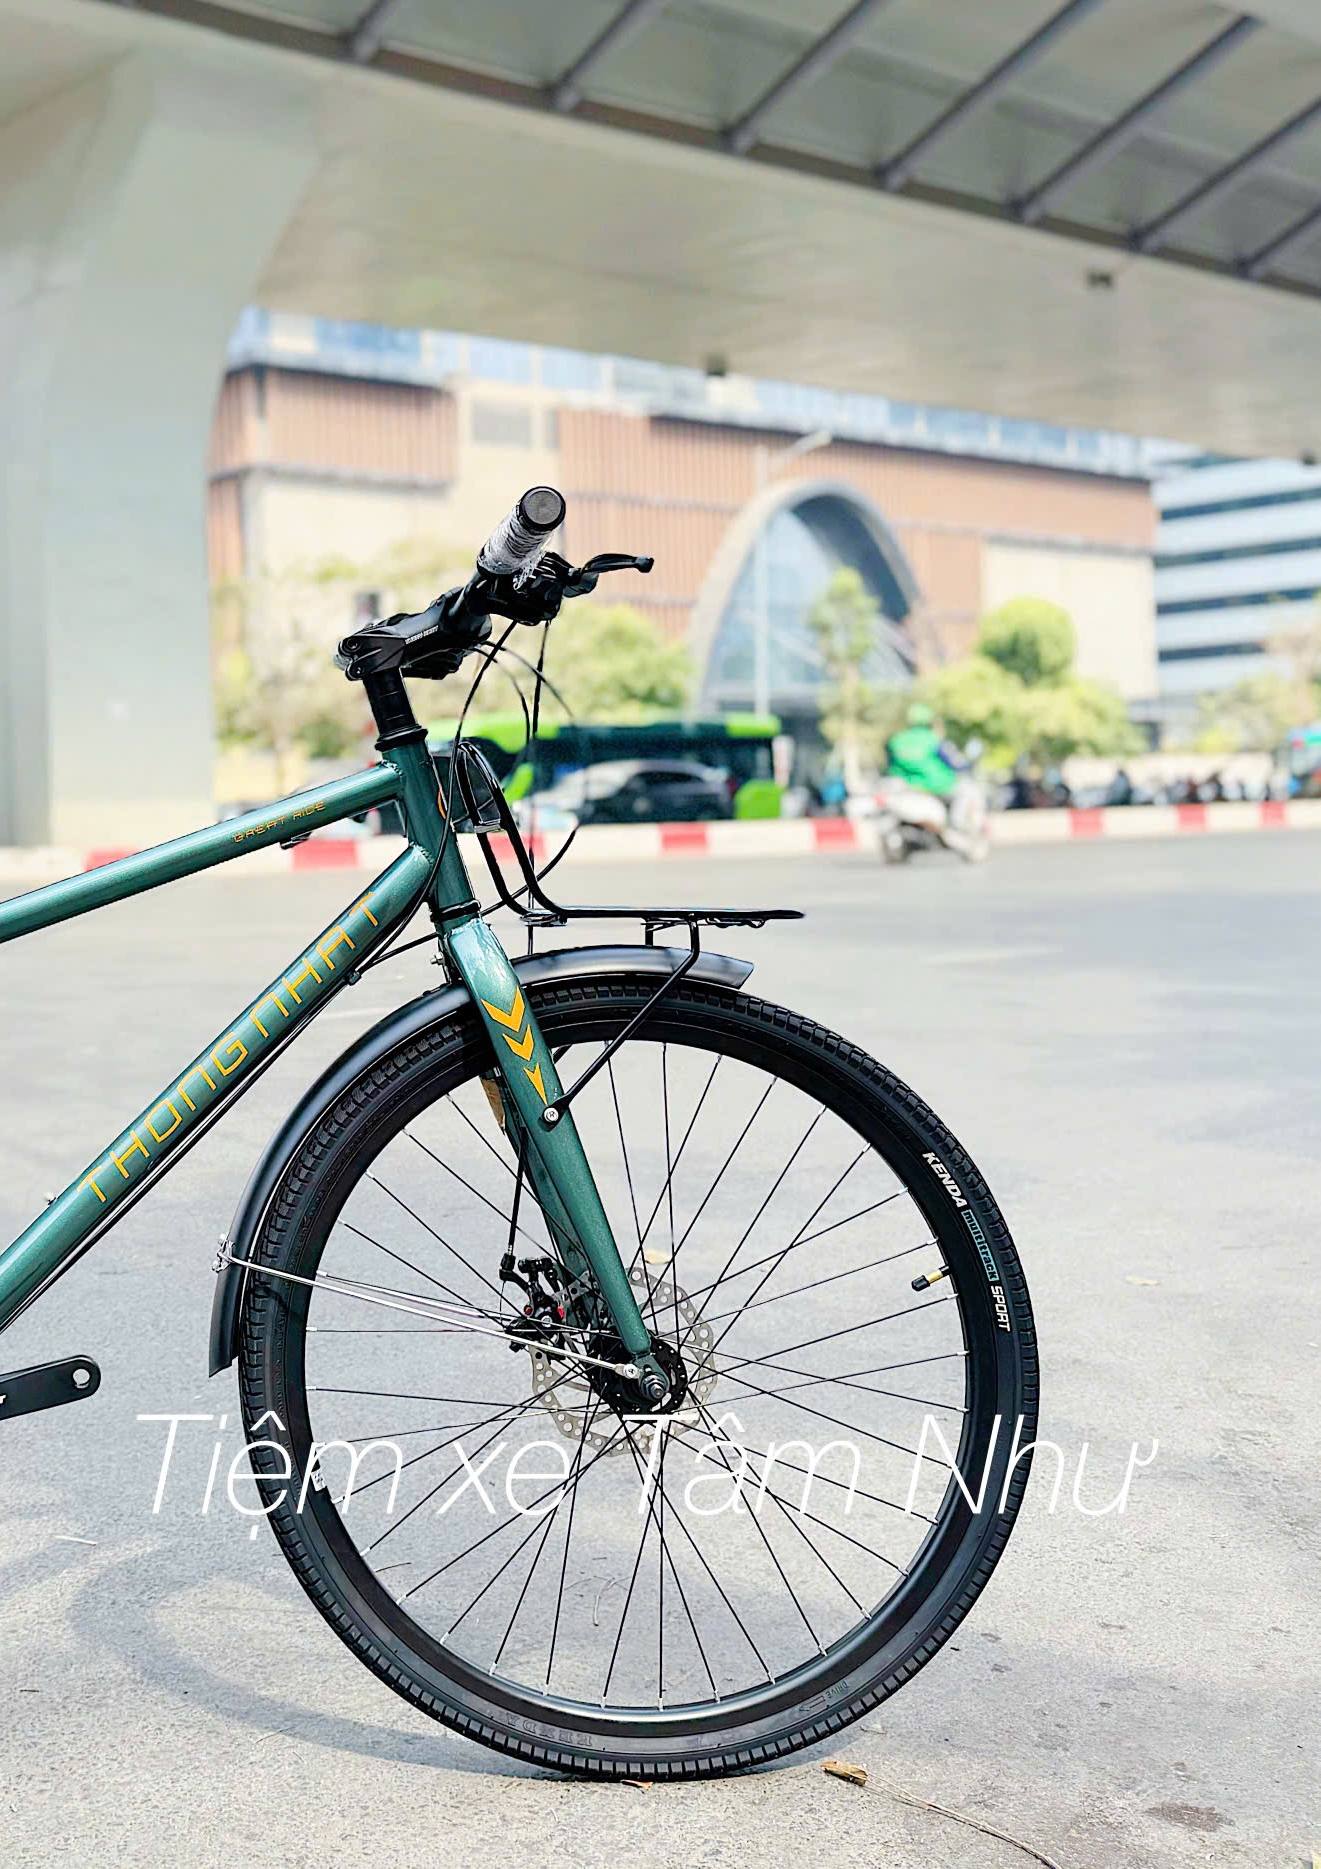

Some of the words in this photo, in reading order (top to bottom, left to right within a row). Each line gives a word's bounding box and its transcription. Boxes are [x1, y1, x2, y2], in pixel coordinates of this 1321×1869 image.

[232, 816, 287, 844] GREAT
[292, 801, 327, 821] RIDE
[922, 1151, 968, 1209] KENDA
[962, 1211, 999, 1281] multitrack
[990, 1285, 1011, 1332] SPORT
[506, 1712, 593, 1747] KENDA
